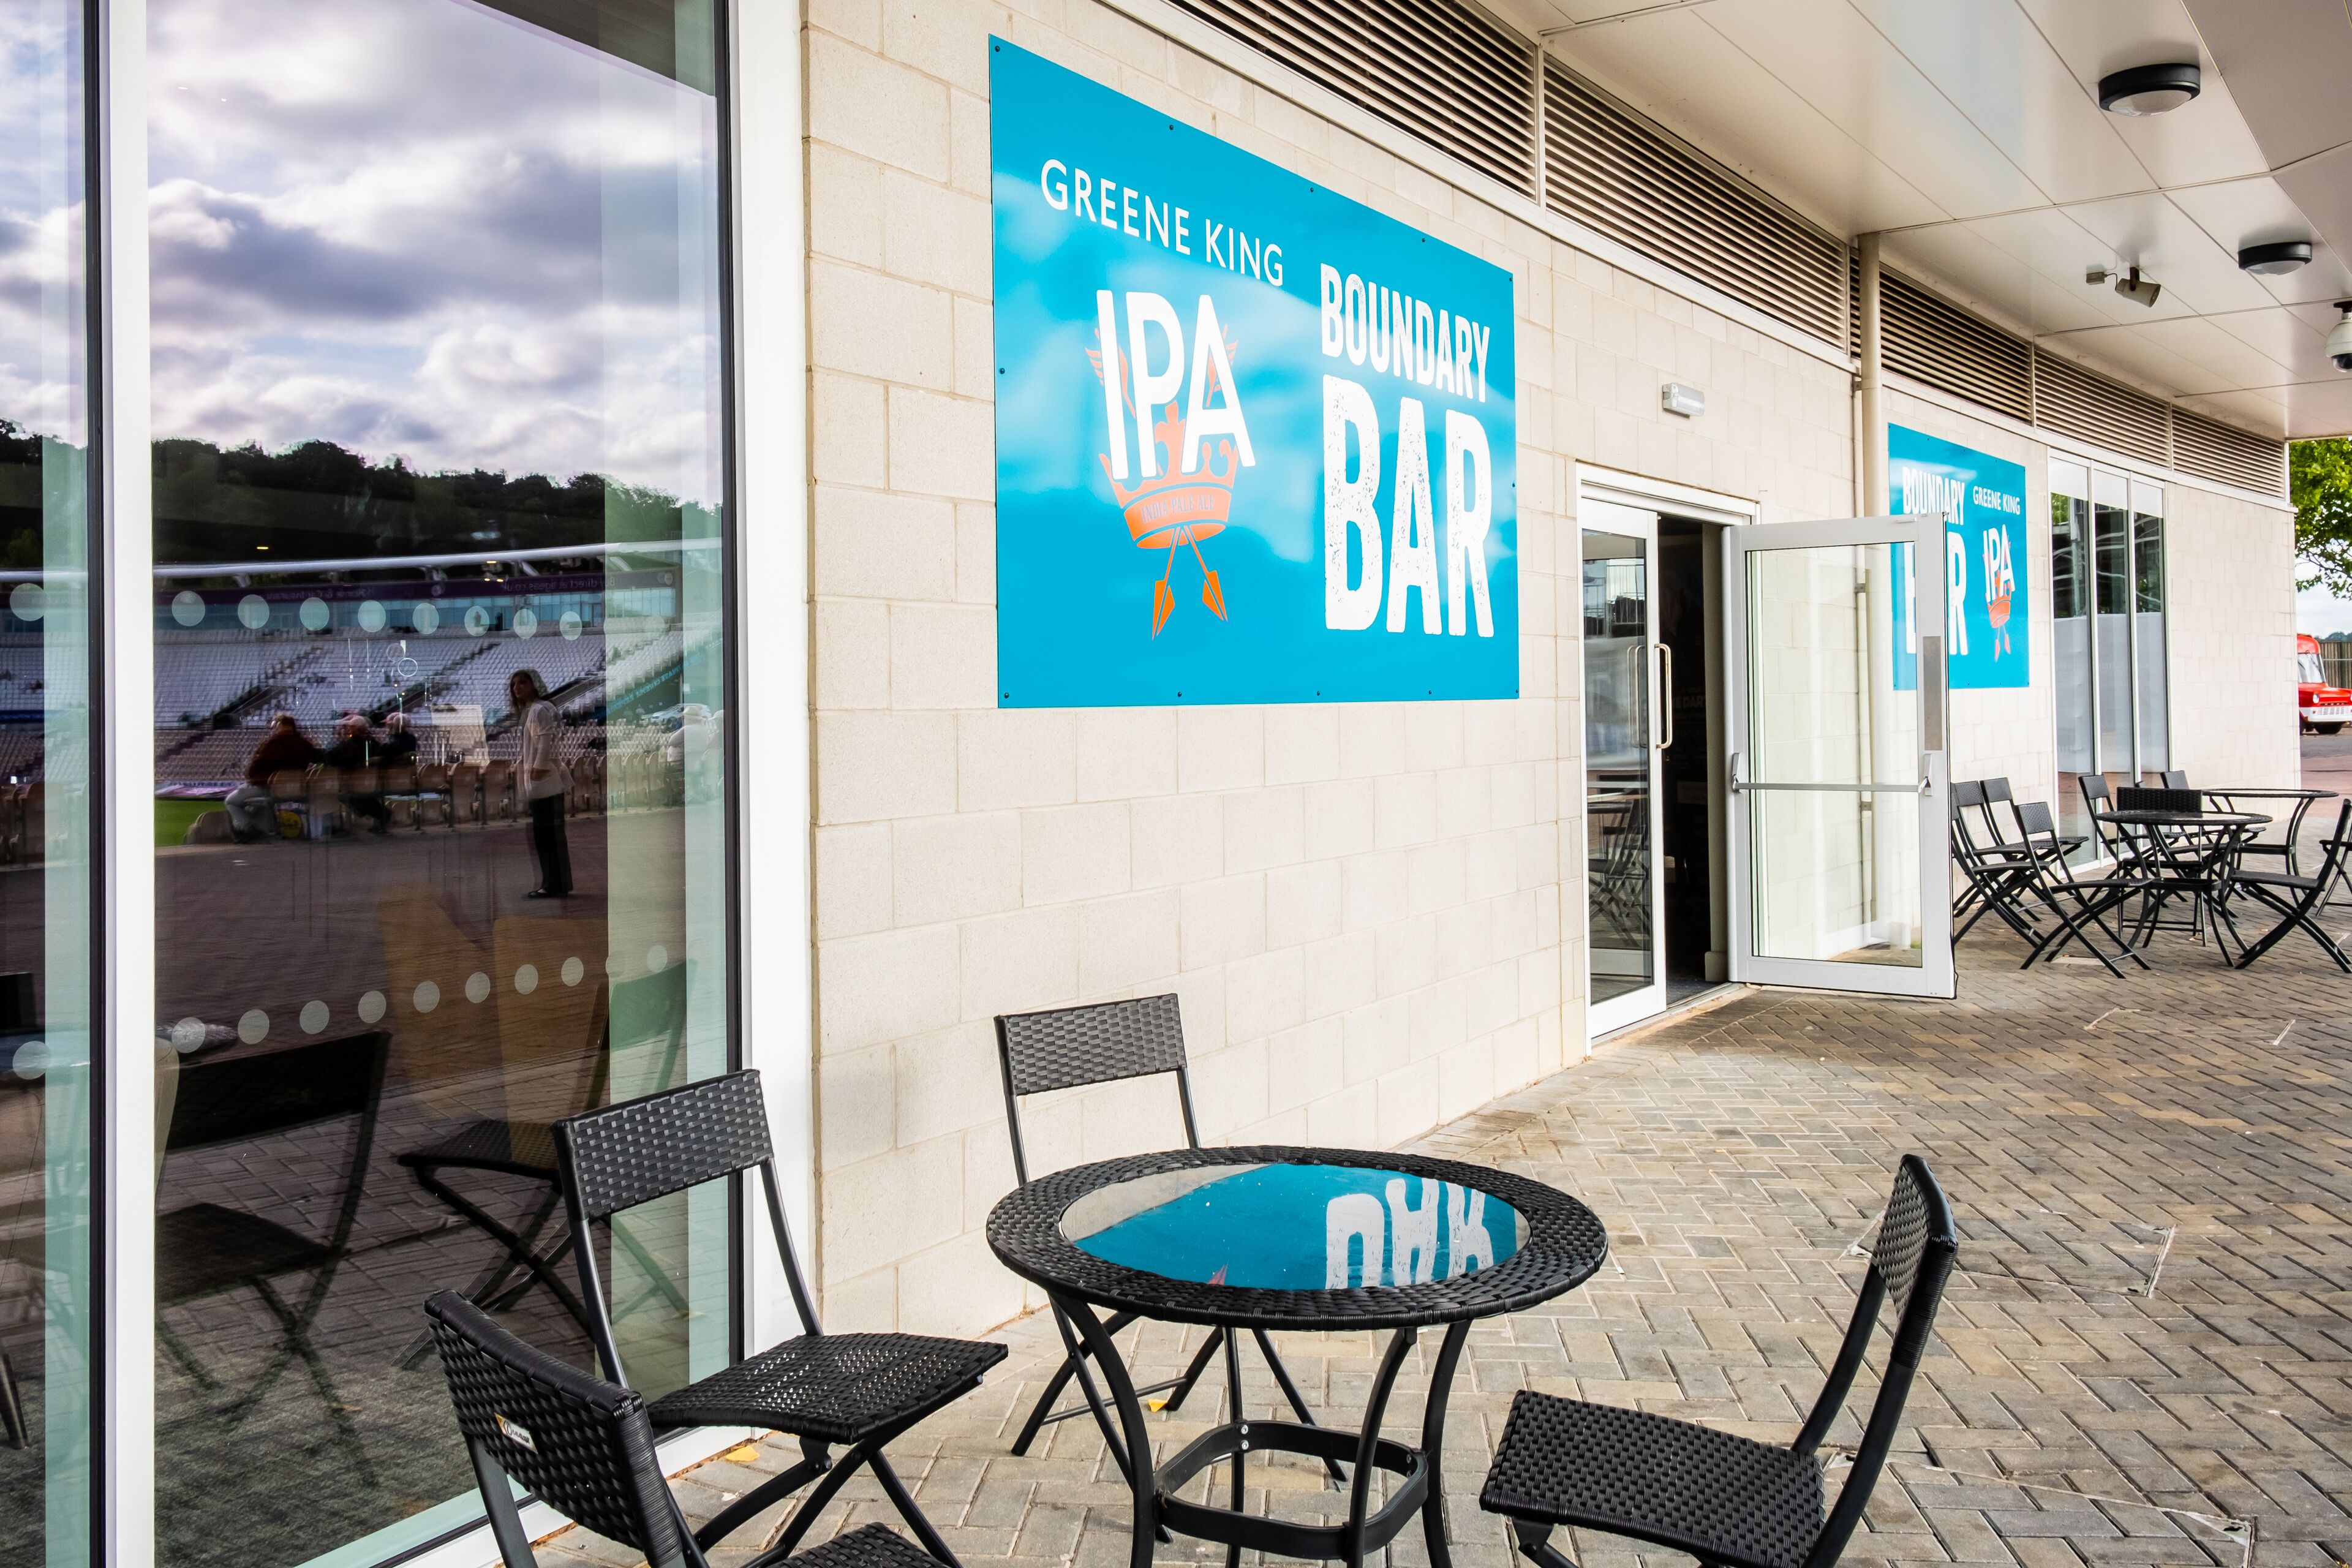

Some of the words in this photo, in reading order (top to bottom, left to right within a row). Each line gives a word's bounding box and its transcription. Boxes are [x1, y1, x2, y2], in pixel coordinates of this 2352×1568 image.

[1041, 158, 1190, 255] GREENE
[1205, 218, 1284, 287] KING
[1096, 289, 1256, 480] IPA
[1321, 263, 1490, 402] BOUNDARY
[1141, 498, 1169, 524] INDIA
[1171, 494, 1194, 514] PALE
[1197, 494, 1215, 510] ALE
[1323, 374, 1494, 638] BAR
[1902, 467, 1965, 526] BOUNDARY
[1972, 485, 2002, 511] GREENE
[2002, 494, 2020, 515] KING
[1983, 524, 2015, 603] IPA
